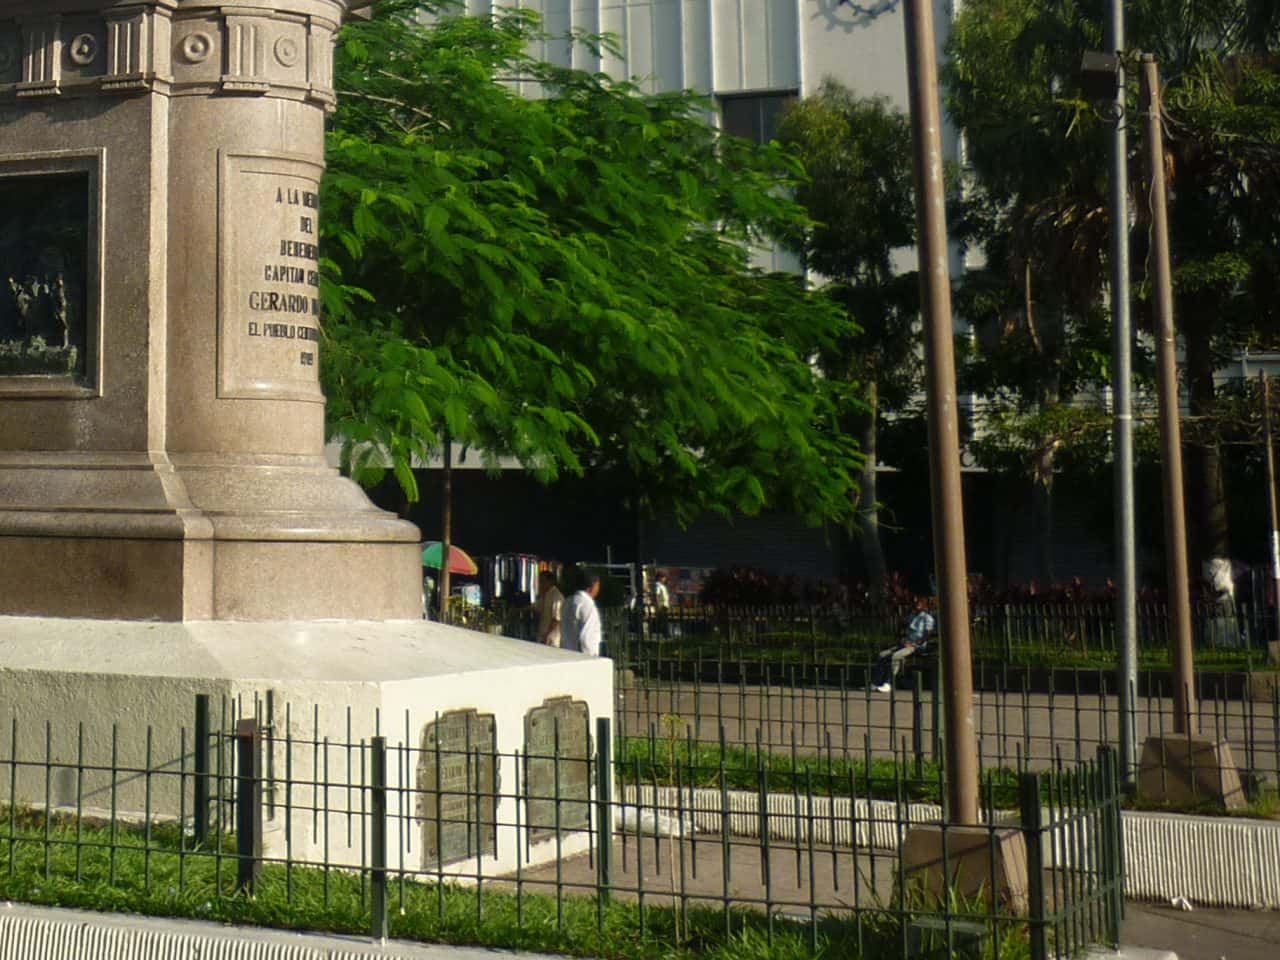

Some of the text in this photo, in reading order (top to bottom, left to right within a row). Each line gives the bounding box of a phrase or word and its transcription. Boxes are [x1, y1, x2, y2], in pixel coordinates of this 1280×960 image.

[276, 187, 282, 204] A
[287, 188, 299, 205] LA
[300, 216, 312, 234] DEL
[265, 265, 304, 284] CAPITAN
[249, 291, 308, 313] GERARDO
[248, 322, 261, 336] EL
[264, 323, 295, 339] PUEBLO
